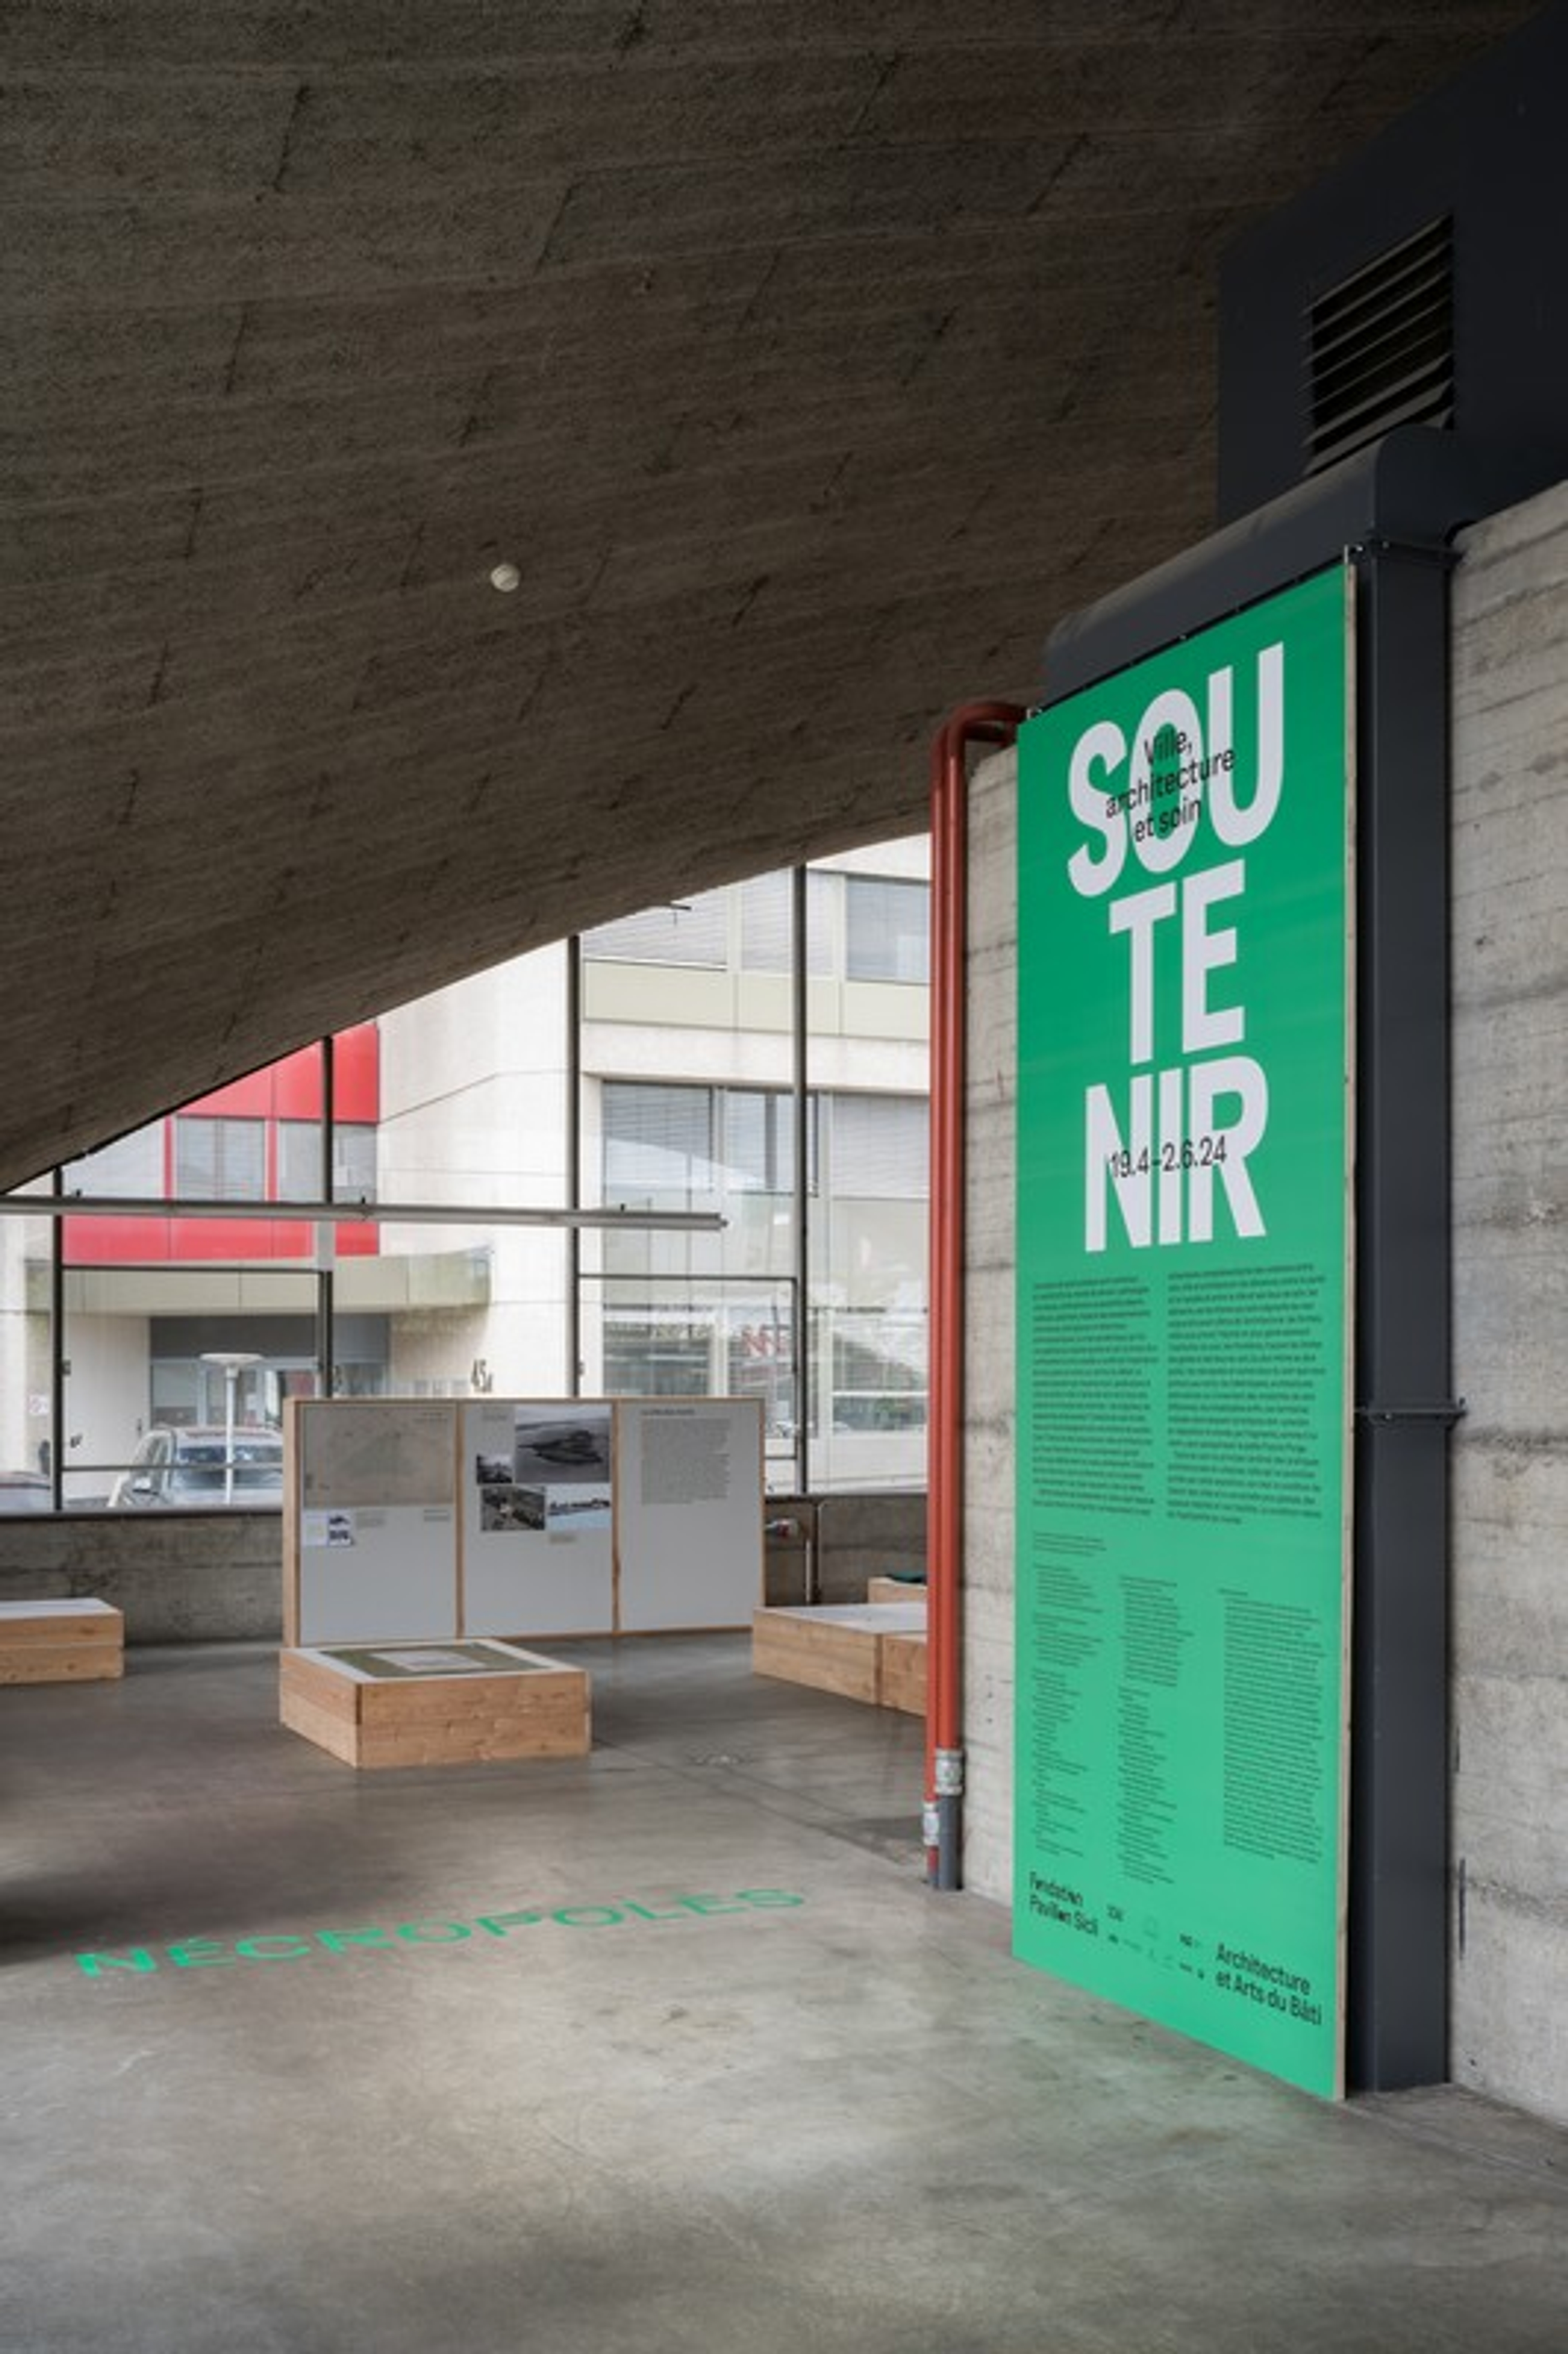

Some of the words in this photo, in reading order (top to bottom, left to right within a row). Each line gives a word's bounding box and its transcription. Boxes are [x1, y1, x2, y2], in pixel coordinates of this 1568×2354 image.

[1068, 641, 1283, 897] SOU
[1145, 732, 1192, 766] Ville,
[1106, 750, 1234, 818] architecture
[1136, 813, 1155, 841] et
[1159, 796, 1201, 833] soin
[1109, 858, 1244, 1066] TE
[1086, 1056, 1268, 1252] NIR
[75, 1888, 805, 1977] NÉCROPOLES
[1216, 1942, 1310, 1997] Architecture
[1216, 1971, 1231, 1990] et
[1233, 1975, 1264, 2004] Arts
[1267, 1989, 1286, 2011] du
[1291, 1995, 1321, 2025] Bâti
